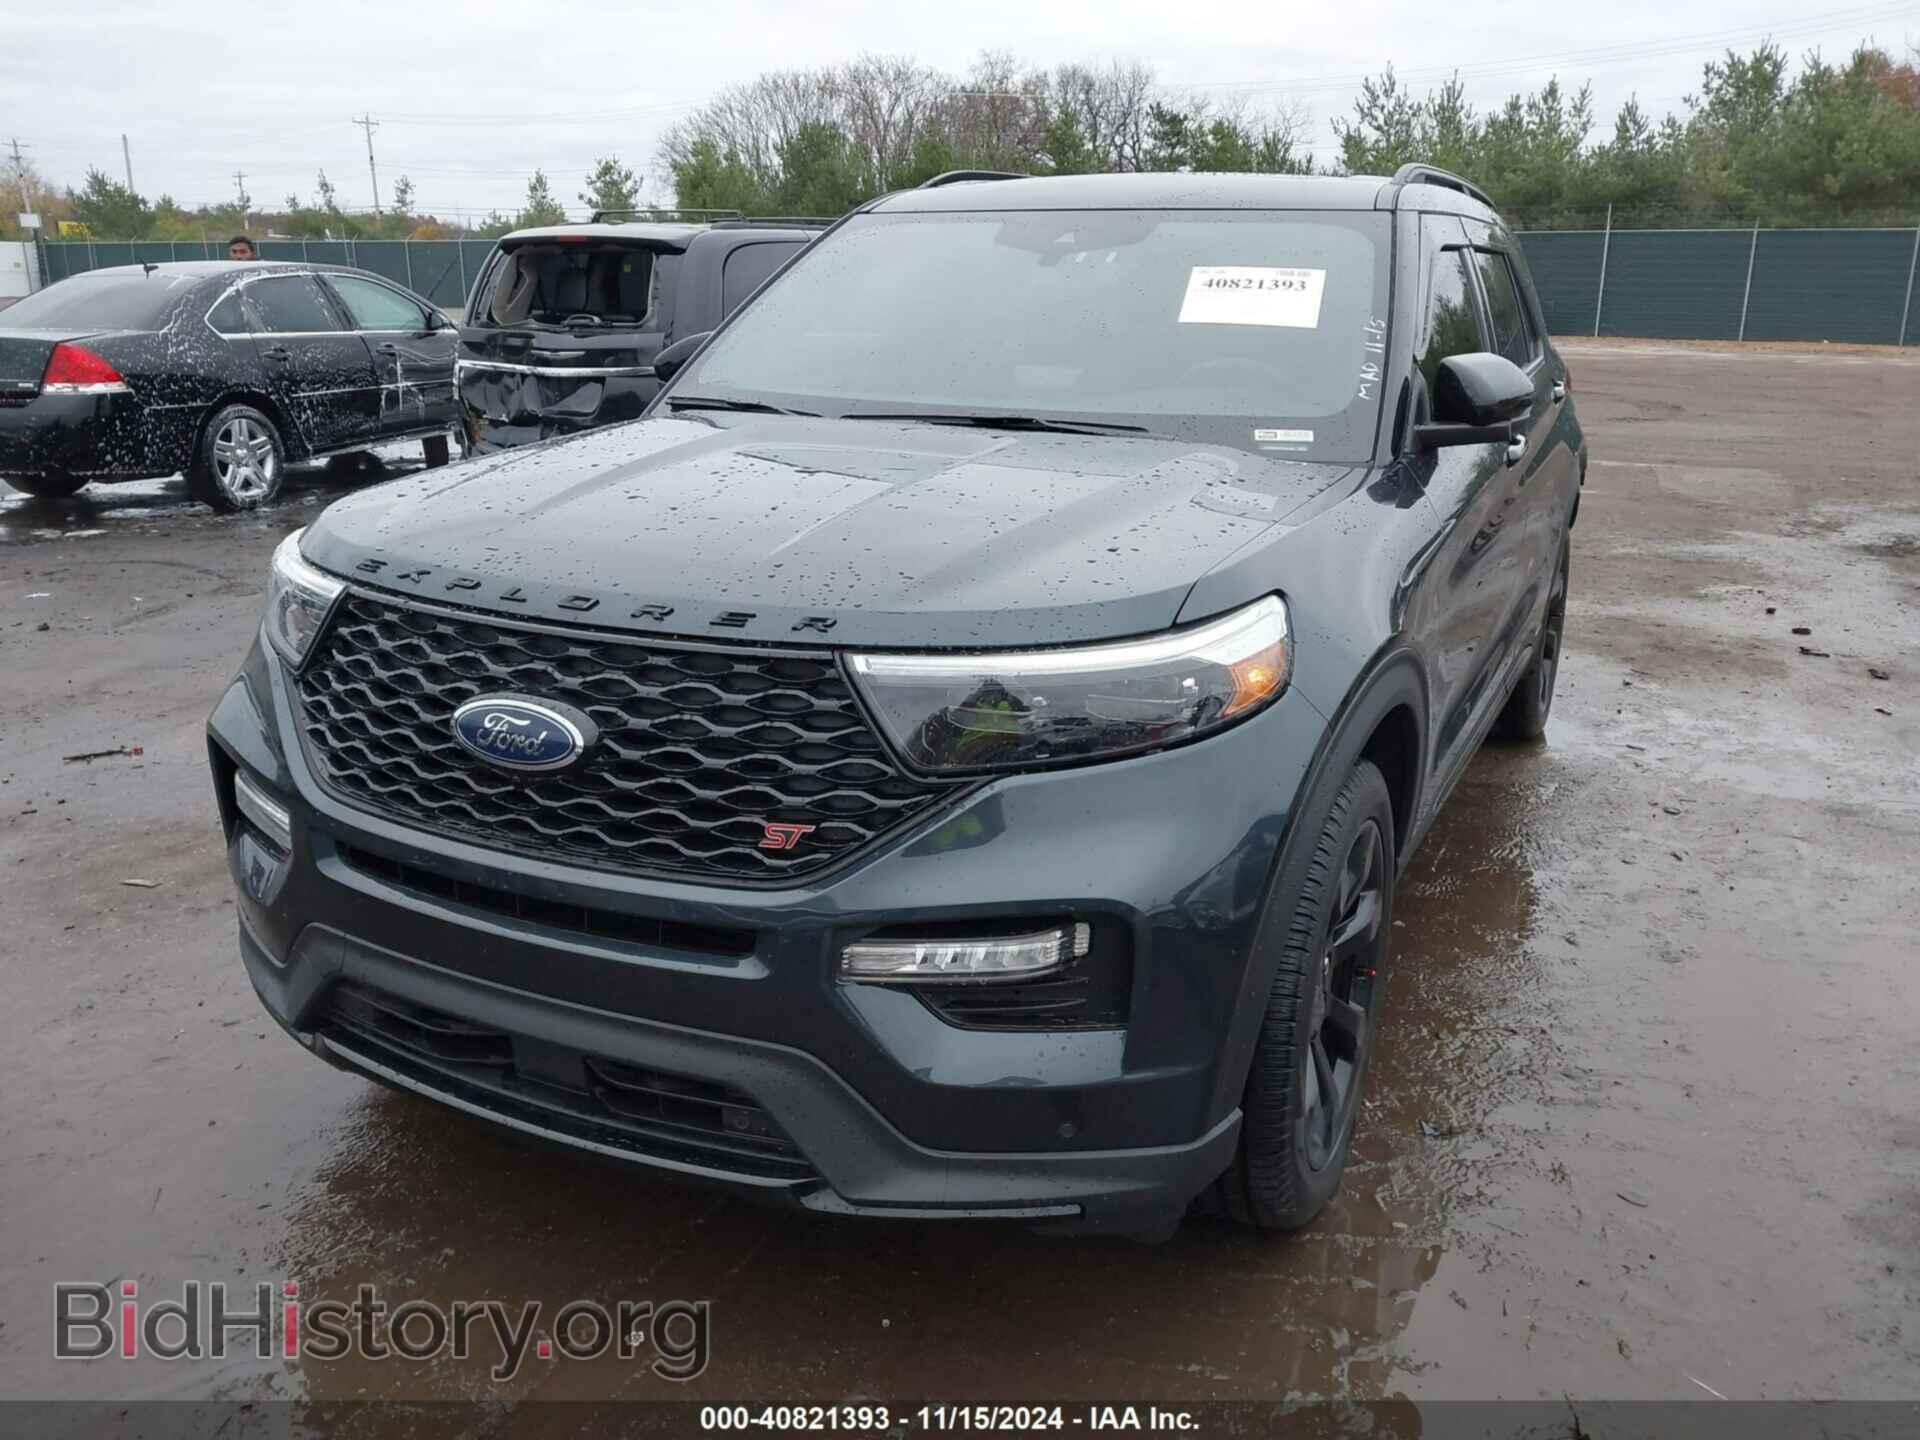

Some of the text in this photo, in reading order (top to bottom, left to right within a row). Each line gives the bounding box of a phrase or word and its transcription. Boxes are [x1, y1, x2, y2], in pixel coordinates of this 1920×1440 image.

[1202, 277, 1307, 292] 40821393
[355, 558, 837, 633] EXPLORER
[476, 712, 548, 756] Ford
[758, 822, 816, 849] ST
